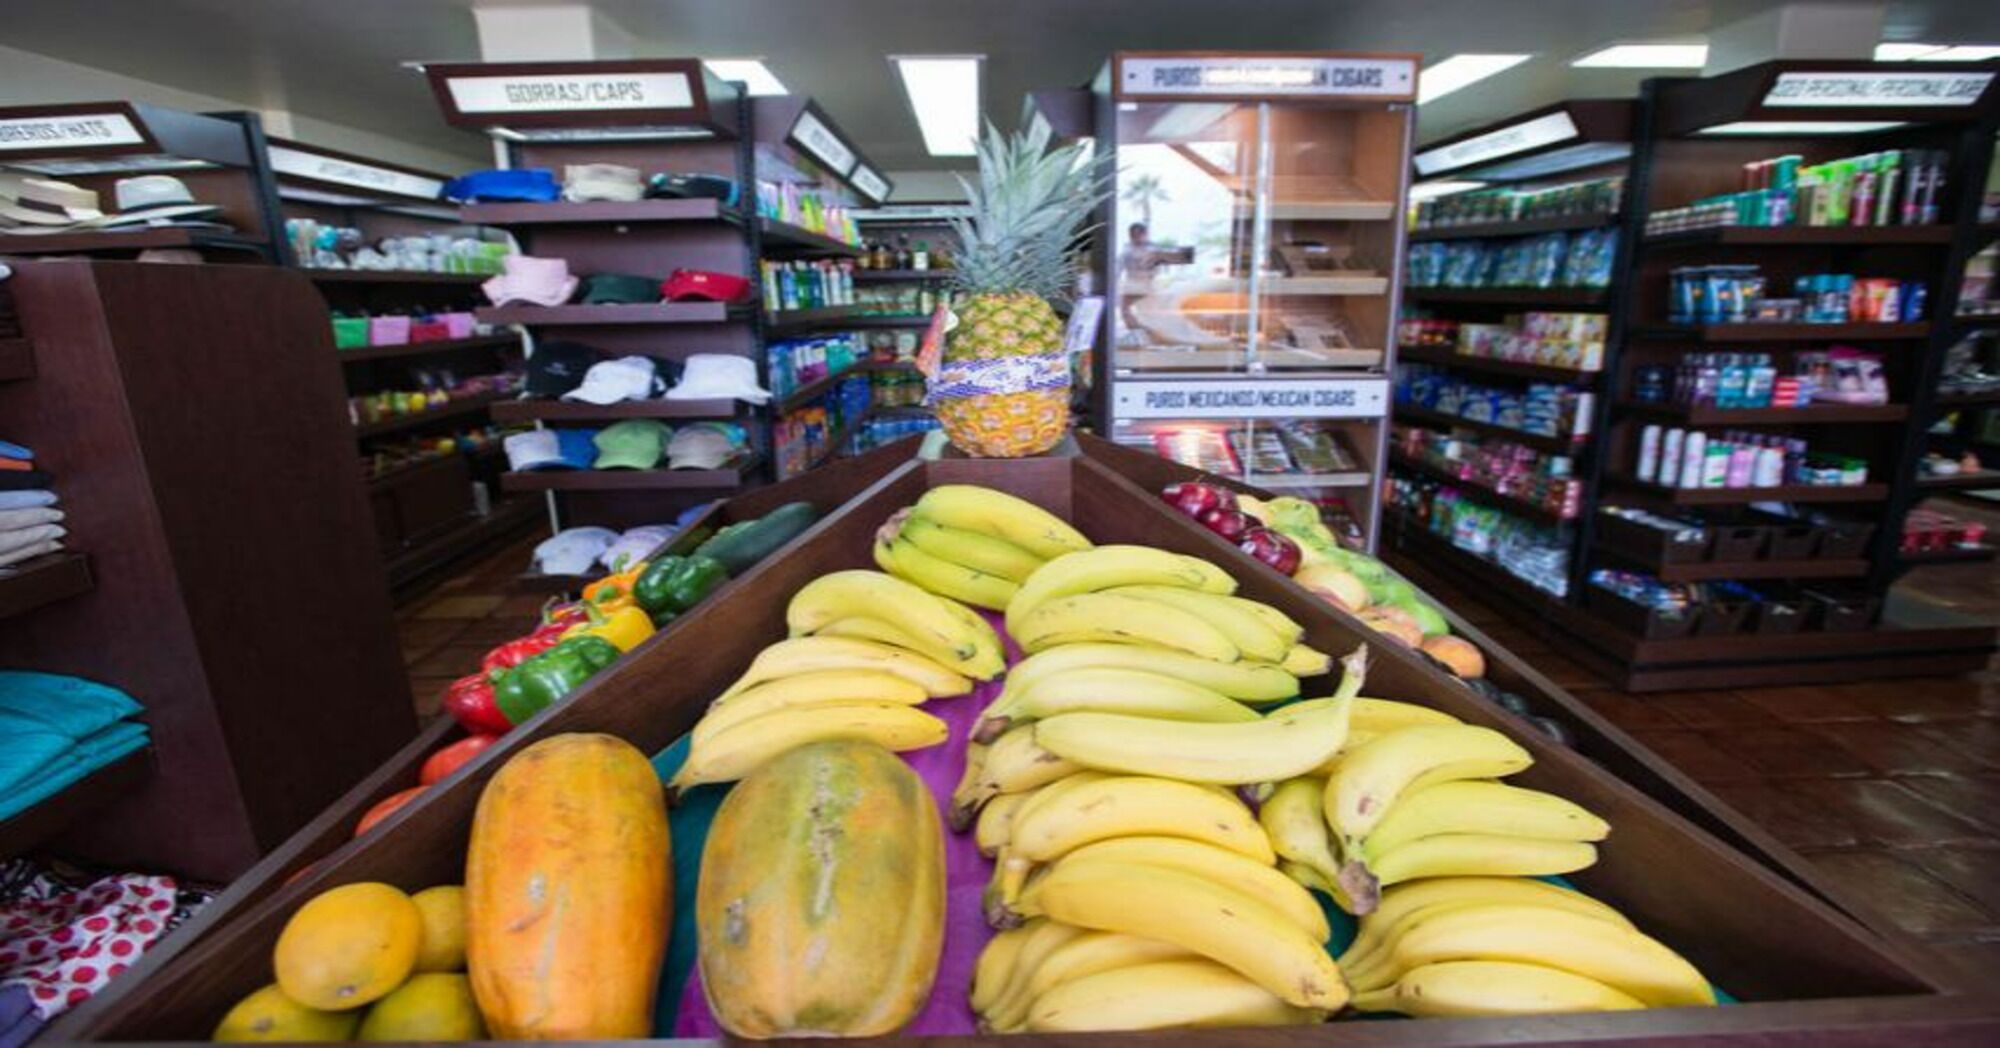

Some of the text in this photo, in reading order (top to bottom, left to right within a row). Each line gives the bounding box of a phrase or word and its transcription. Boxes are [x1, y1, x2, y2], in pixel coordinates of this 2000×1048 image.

[1153, 67, 1201, 87] PUROS
[1332, 67, 1383, 87] CIGARS
[505, 81, 645, 103] GORRAS/CAPS
[1146, 389, 1357, 408] PUROS MEXICANOS/MEXICAN CIGARS
